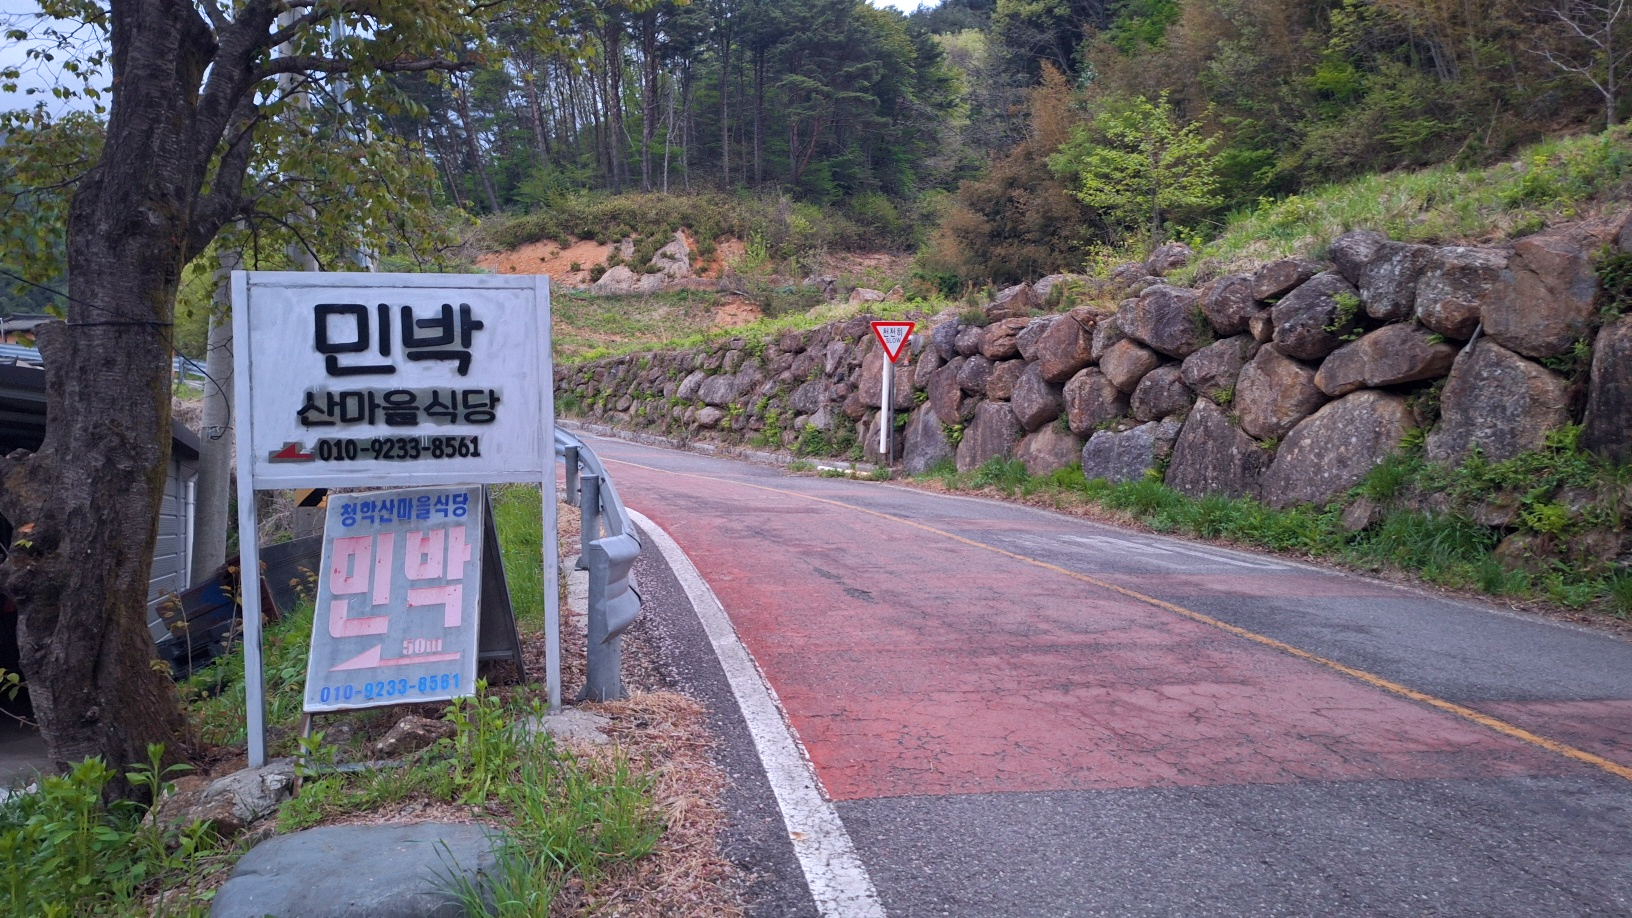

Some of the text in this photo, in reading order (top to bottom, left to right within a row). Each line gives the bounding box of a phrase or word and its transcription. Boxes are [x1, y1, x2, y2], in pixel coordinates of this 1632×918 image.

[314, 303, 484, 376] 민박
[883, 327, 903, 338] 천천히
[296, 389, 501, 427] 산마을식당
[319, 435, 481, 461] 010-9233-8561
[341, 493, 469, 527] 청학산마을식당
[329, 526, 472, 638] 민박
[402, 638, 442, 655] 50m
[320, 673, 461, 703] 010-9233-8561
